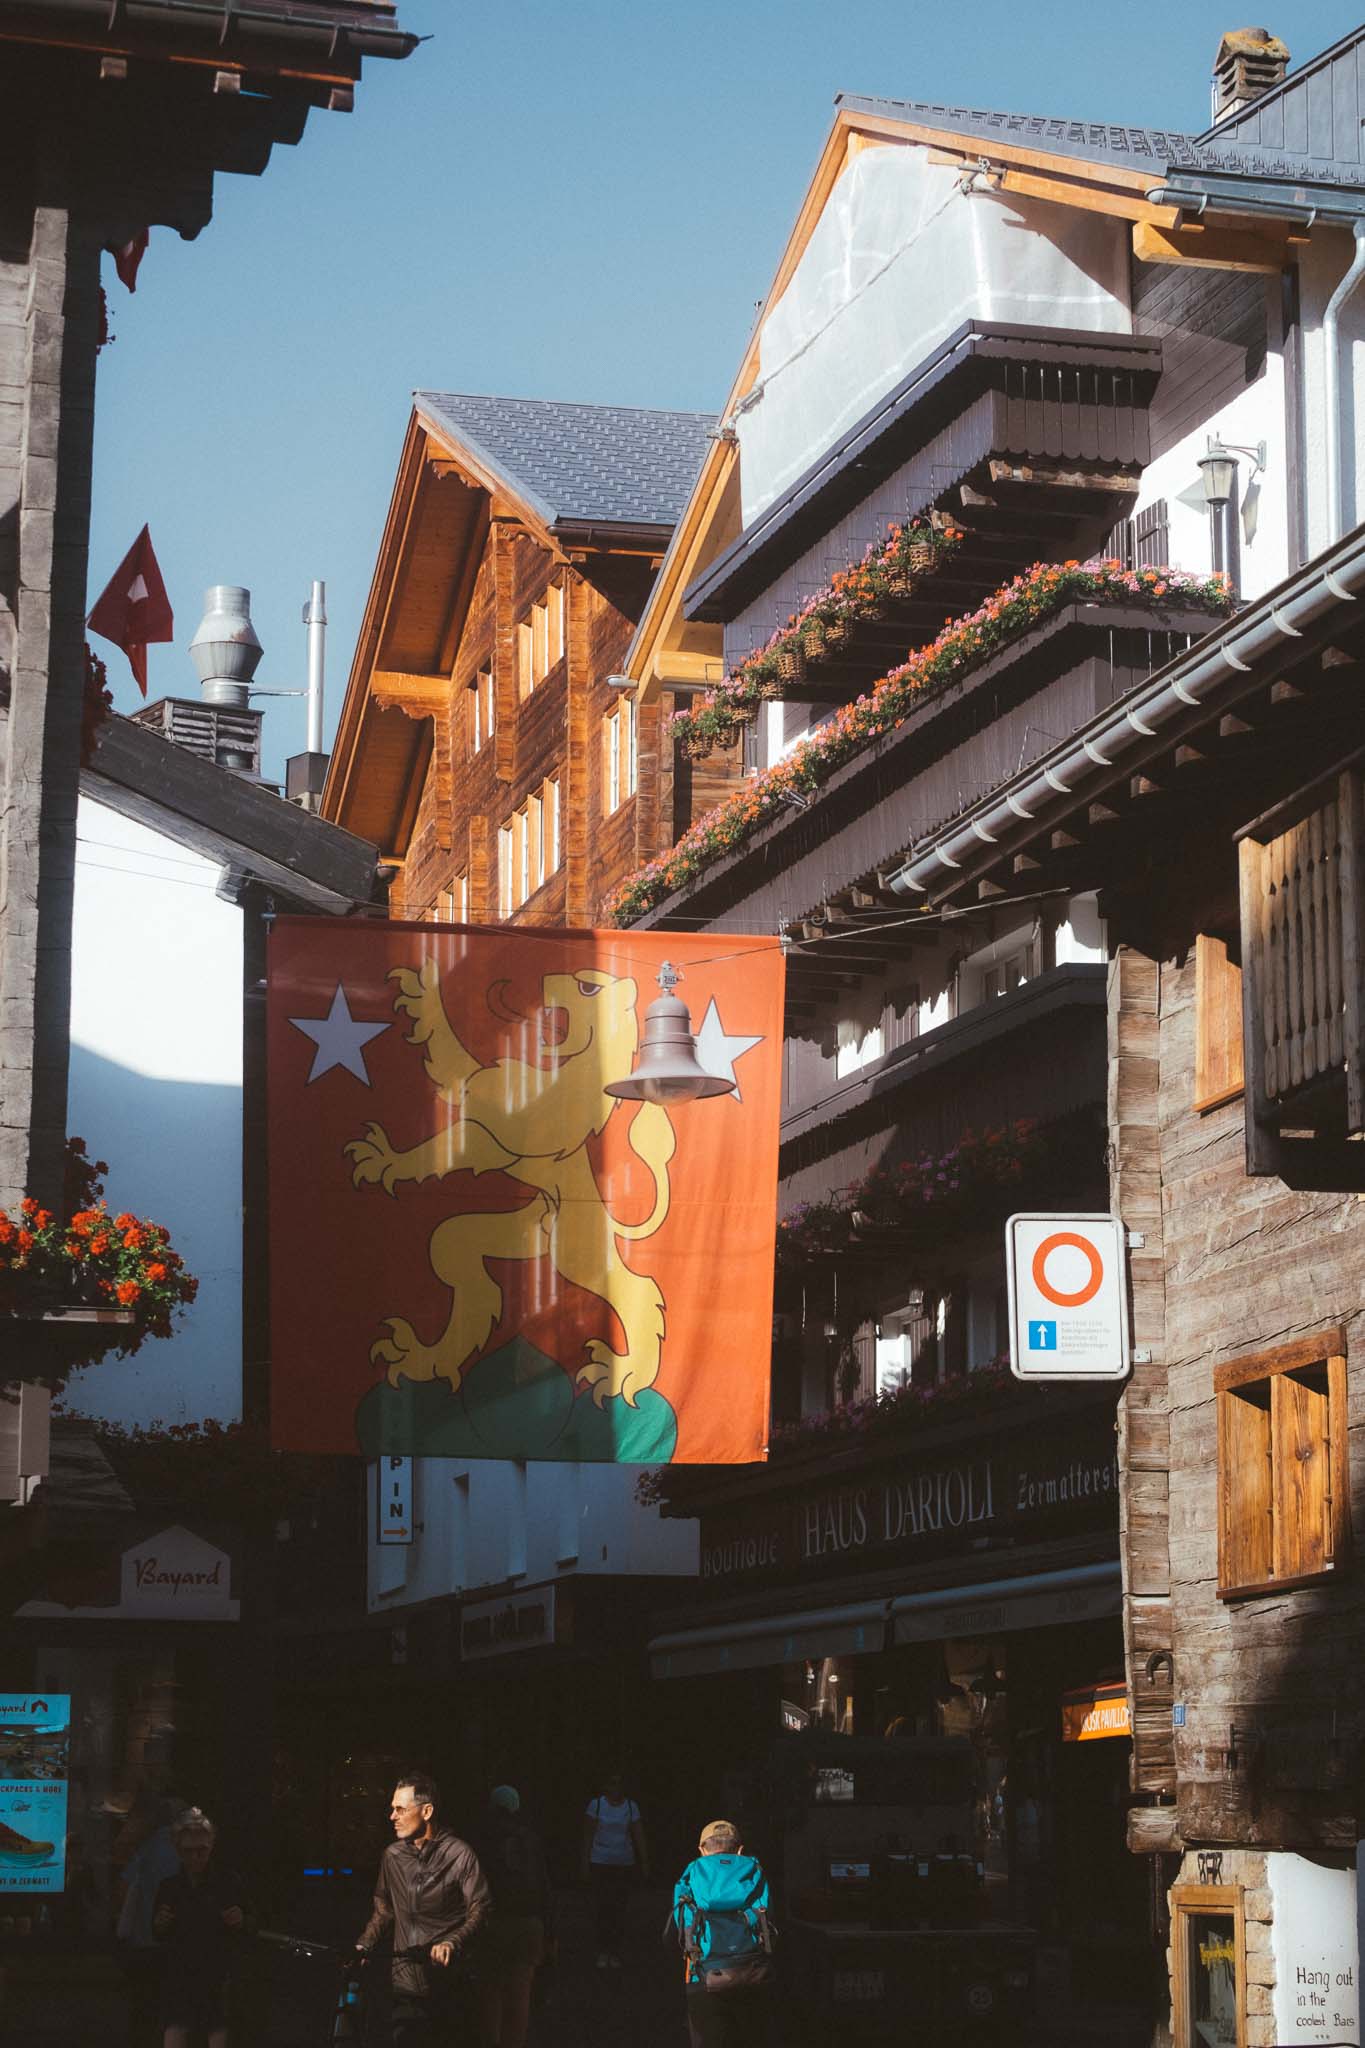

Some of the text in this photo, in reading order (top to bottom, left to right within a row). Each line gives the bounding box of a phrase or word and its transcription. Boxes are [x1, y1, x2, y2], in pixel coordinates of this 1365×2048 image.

[802, 1459, 996, 1558] HAUS DARIOLI
[703, 1532, 778, 1577] BOUTIQUE
[133, 1558, 221, 1596] Bayard
[1296, 1967, 1353, 1992] Hang out
[1297, 1992, 1326, 2006] in the
[1333, 2013, 1355, 2027] Bars
